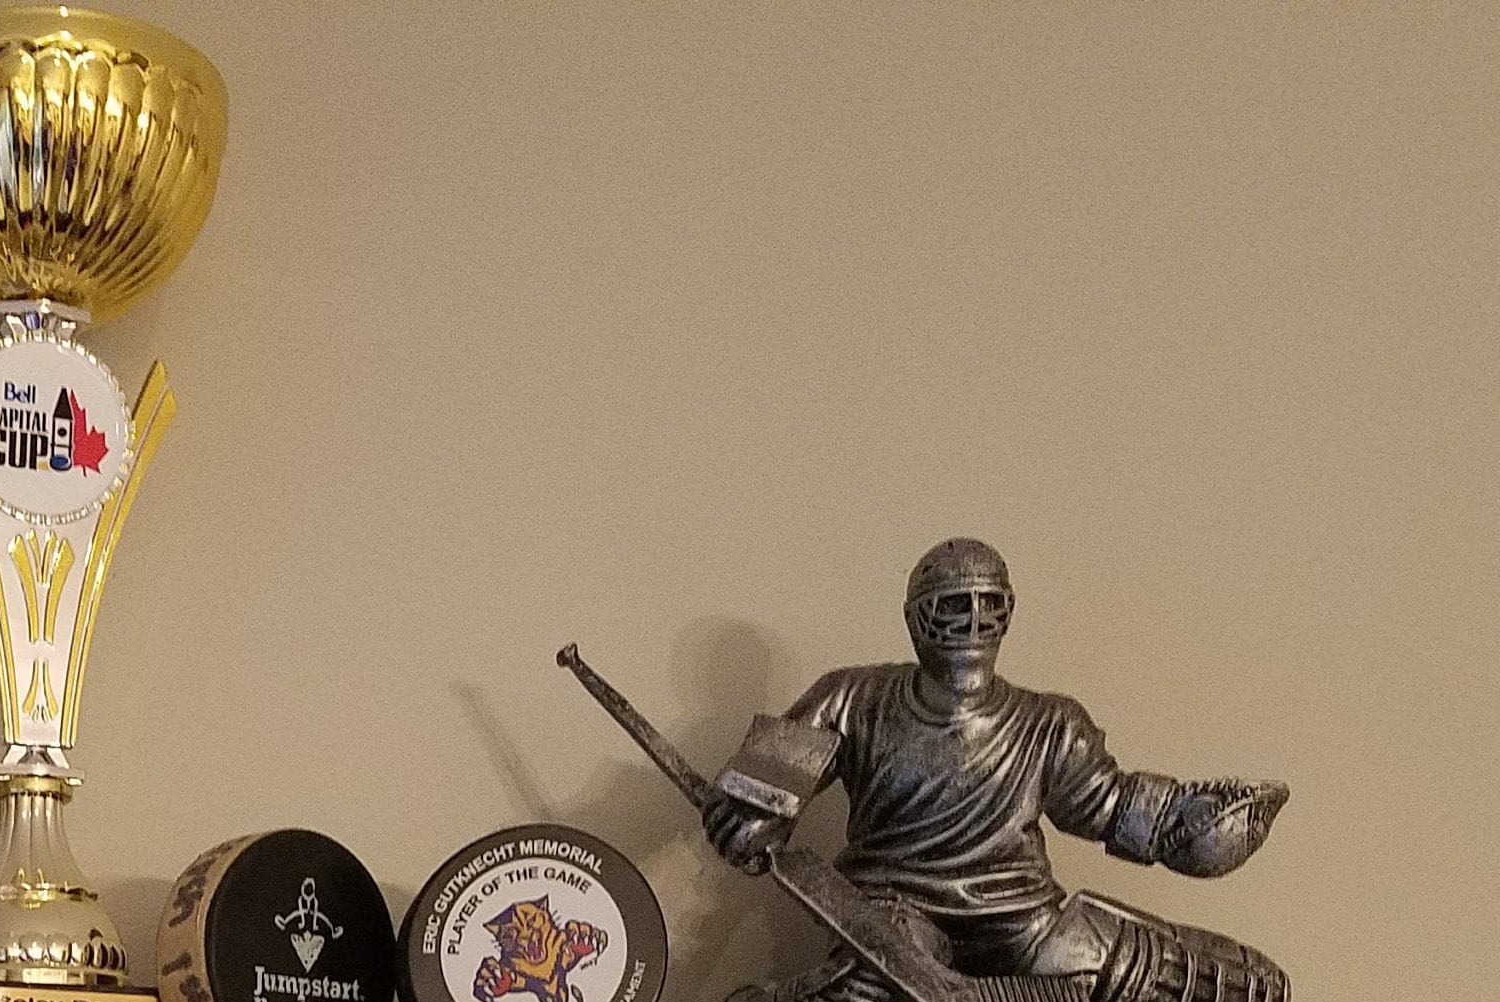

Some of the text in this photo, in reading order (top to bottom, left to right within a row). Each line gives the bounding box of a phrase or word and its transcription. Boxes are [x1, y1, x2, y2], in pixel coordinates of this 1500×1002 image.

[4, 382, 36, 404] Bell
[423, 839, 602, 954] ERIC GUTKNECHT MEMORIAL
[447, 866, 592, 955] PLAYER OF THE GAME
[254, 966, 360, 1001] Jumpstart
